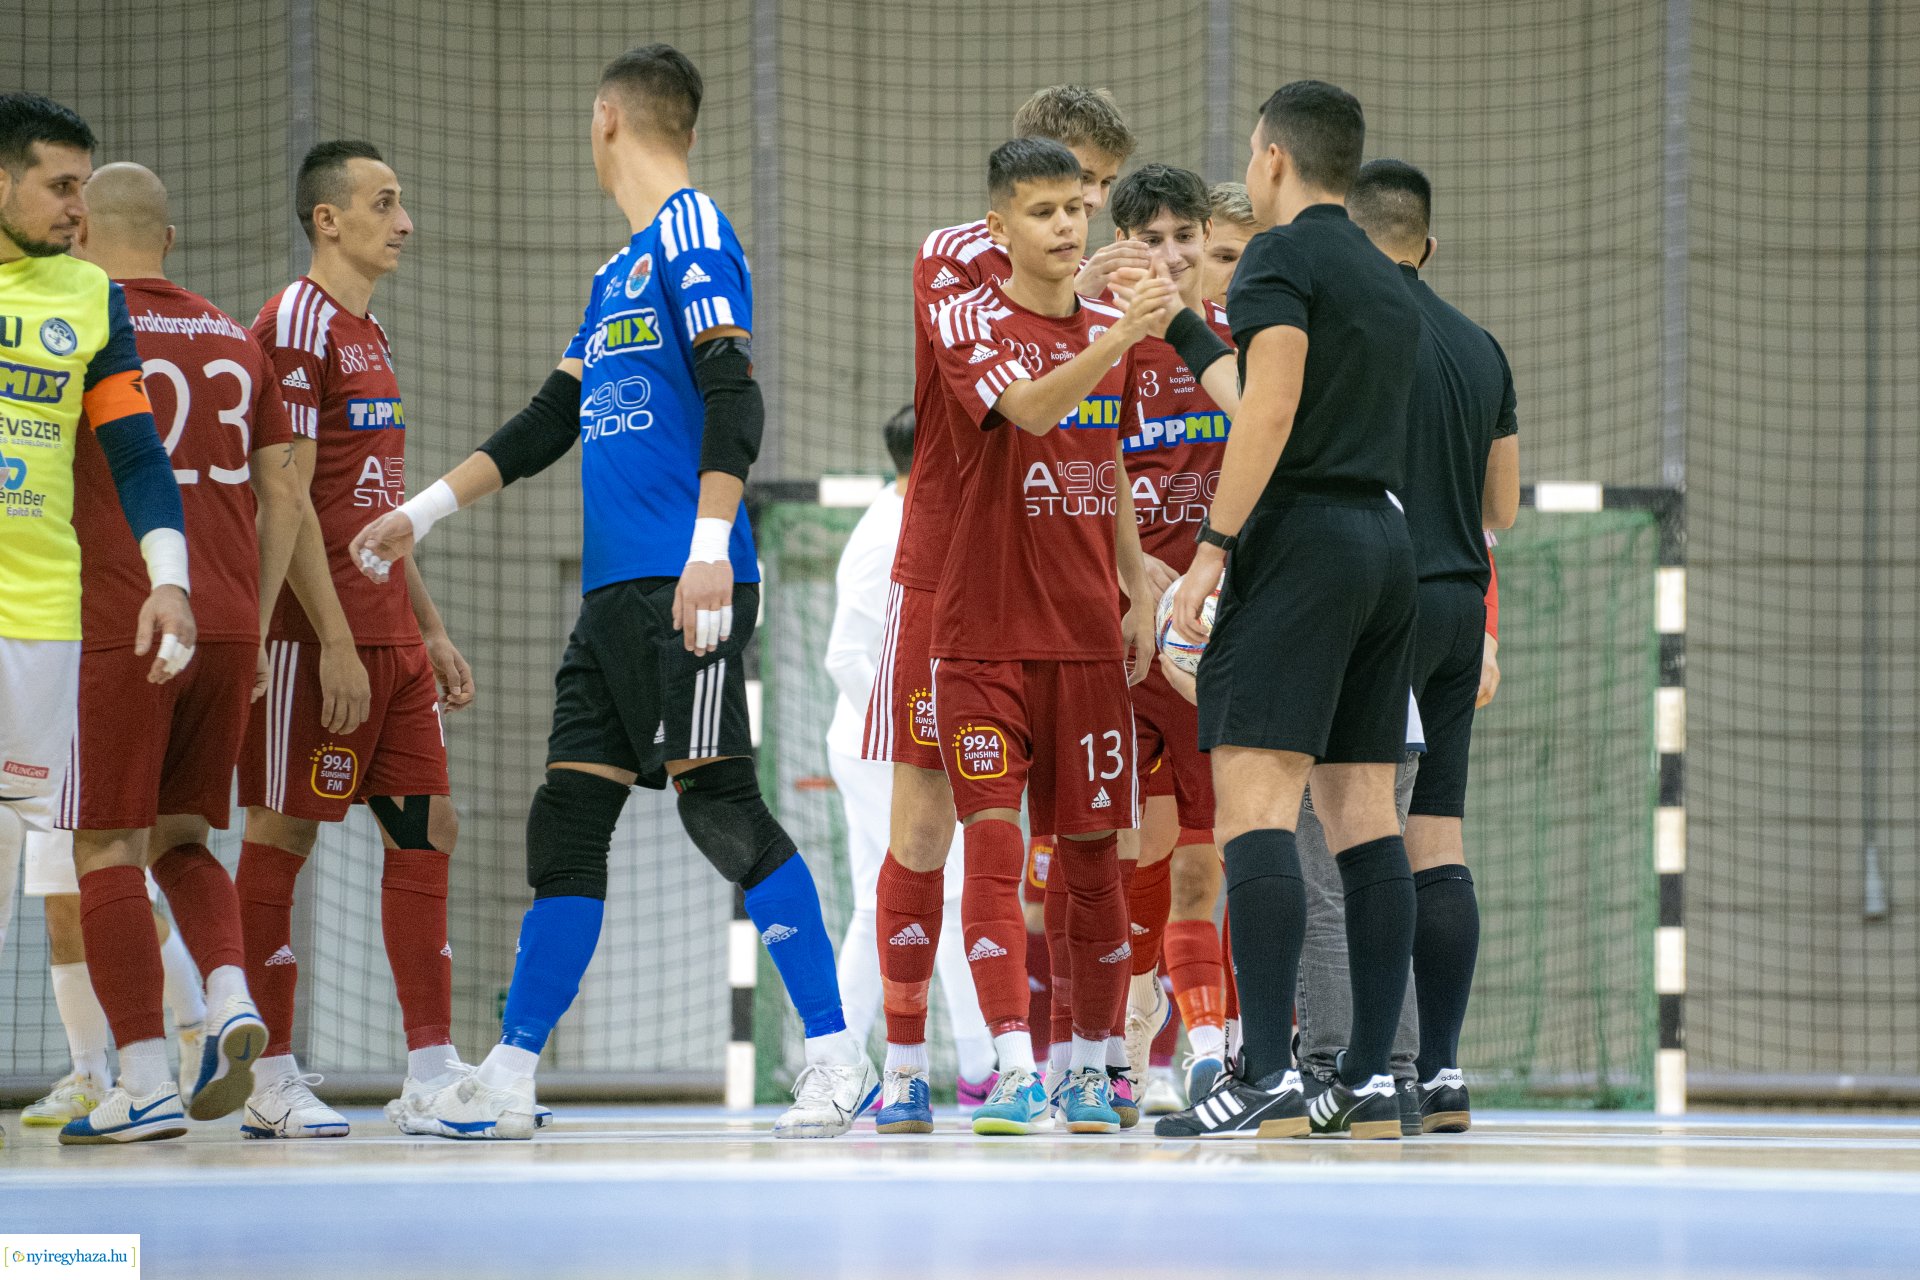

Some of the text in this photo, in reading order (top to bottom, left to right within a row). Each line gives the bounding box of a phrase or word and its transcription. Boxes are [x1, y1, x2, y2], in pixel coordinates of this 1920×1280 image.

[930, 276, 960, 289] adidas
[968, 349, 999, 364] adidas
[1176, 365, 1189, 373] the
[282, 378, 311, 390] adidas
[1173, 386, 1195, 394] water
[141, 358, 252, 485] 23
[963, 734, 999, 752] 99.4
[964, 751, 1000, 761] SUNSHINE
[1080, 729, 1124, 782] 13
[323, 754, 352, 772] 99.4
[973, 759, 994, 773] FM
[320, 770, 351, 780] SUNSHINE
[326, 779, 343, 792] FM
[889, 936, 930, 946] adidas
[264, 955, 297, 967] adida
[967, 947, 1008, 962] adidas
